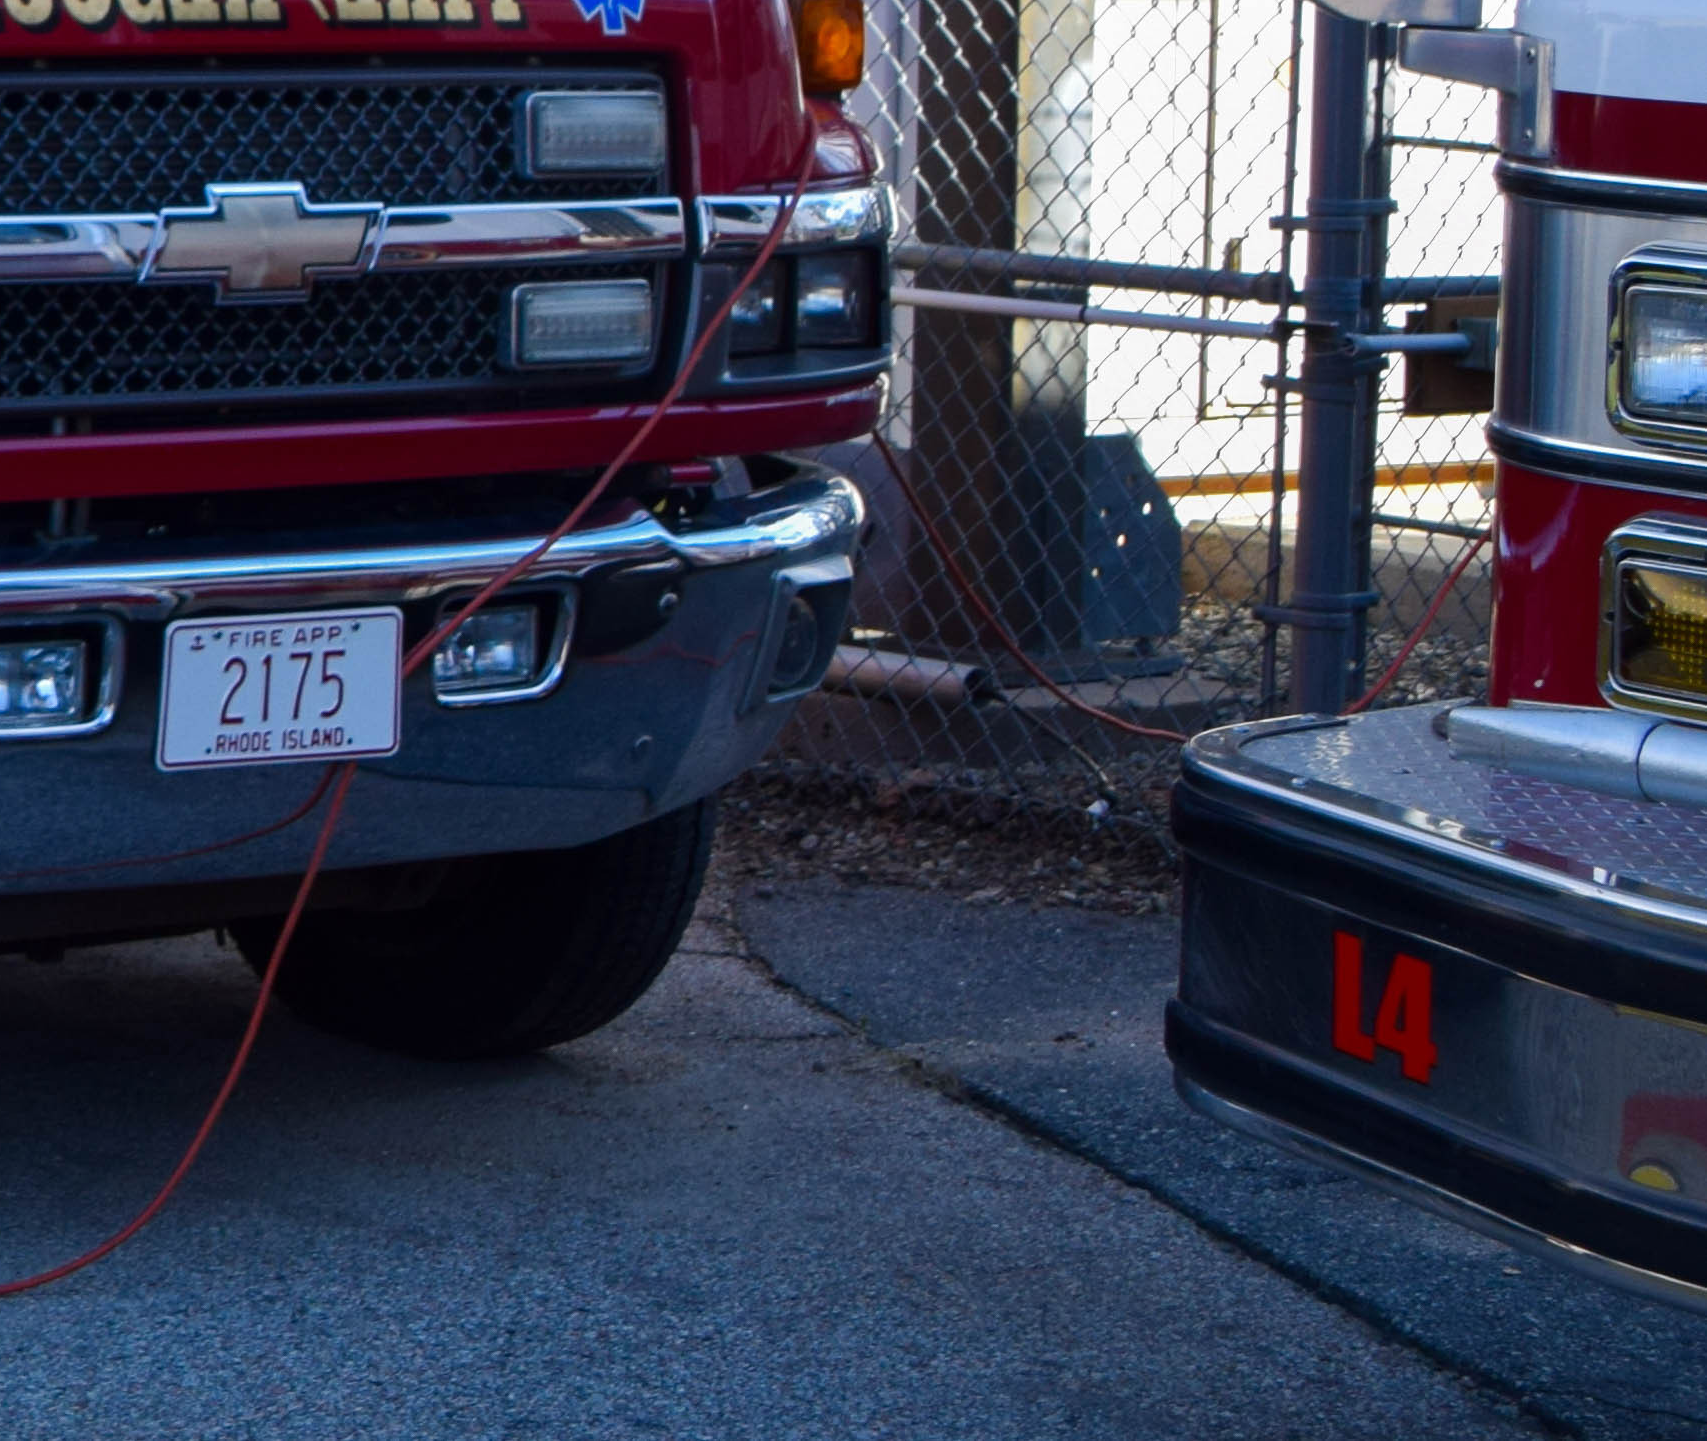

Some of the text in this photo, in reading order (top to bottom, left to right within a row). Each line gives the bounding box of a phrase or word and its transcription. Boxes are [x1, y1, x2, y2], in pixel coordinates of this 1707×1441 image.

[228, 628, 284, 648] FIRE
[220, 649, 346, 726] 2175
[214, 726, 346, 755] RHODE ISLAND
[1332, 928, 1439, 1086] L4
